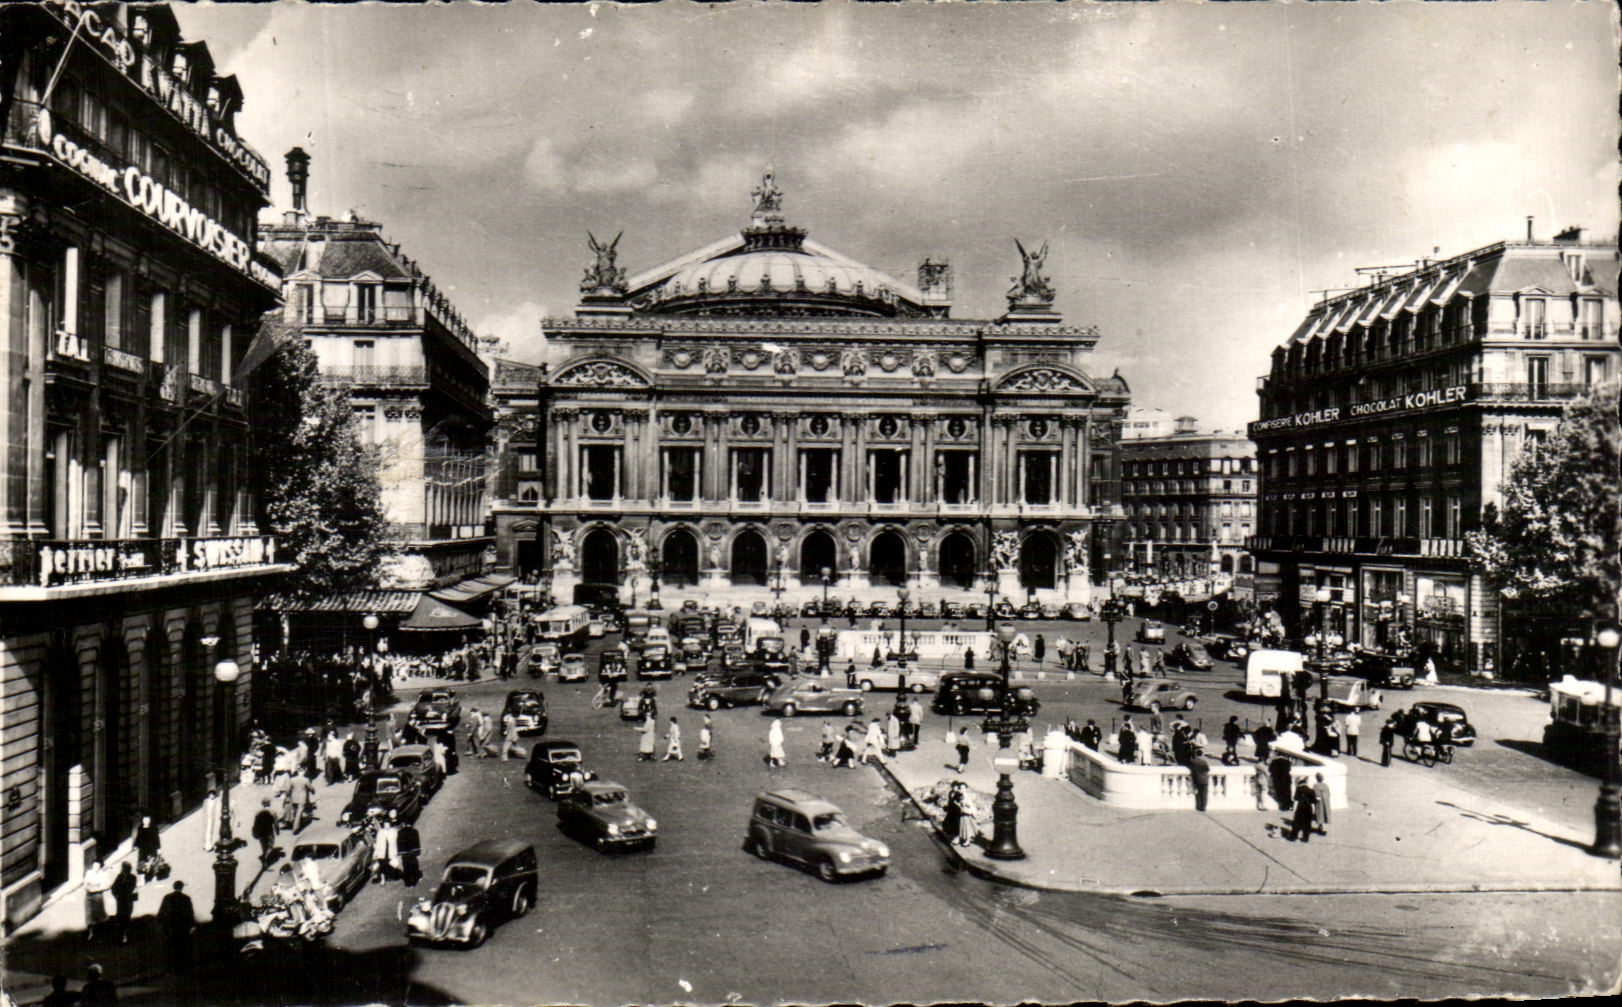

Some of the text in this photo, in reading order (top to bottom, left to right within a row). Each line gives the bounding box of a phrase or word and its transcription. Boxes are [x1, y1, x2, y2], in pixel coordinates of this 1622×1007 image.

[124, 166, 250, 275] COURVOISIER
[1295, 407, 1340, 426] KOHLER
[1350, 398, 1402, 416] CHOCOLAT
[1405, 386, 1467, 409] KOHLER
